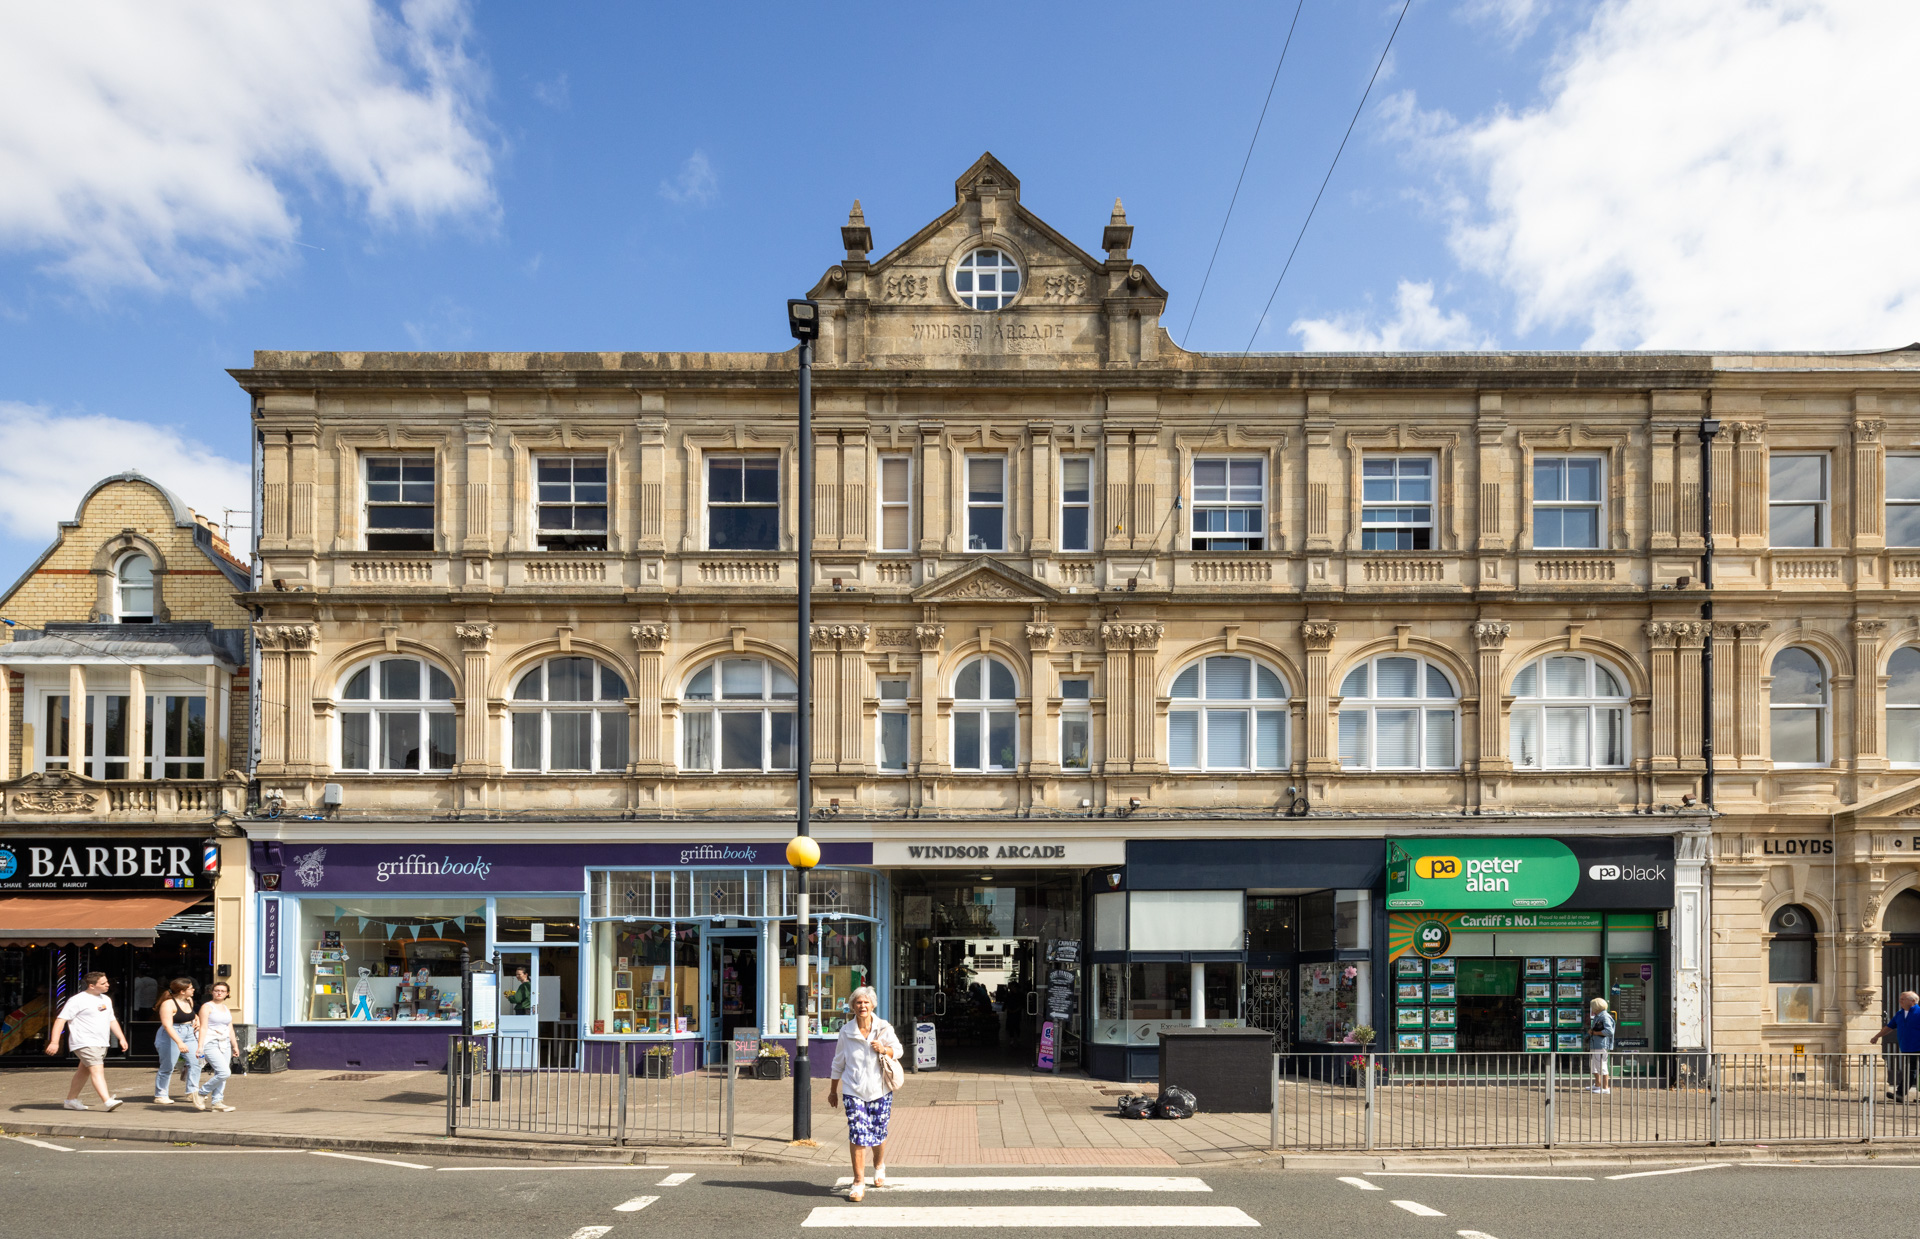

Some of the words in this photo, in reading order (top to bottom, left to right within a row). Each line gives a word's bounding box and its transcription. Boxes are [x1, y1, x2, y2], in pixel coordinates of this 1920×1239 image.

[911, 324, 983, 339] WINDSOR
[993, 324, 1064, 339] ARCADE
[908, 845, 989, 858] WINDSOR
[996, 845, 1065, 858] ARCADE
[1763, 840, 1833, 854] LLOYDS
[28, 846, 195, 877] BARBER
[1431, 859, 1456, 879] pa
[1466, 857, 1522, 878] peter
[1599, 867, 1616, 880] pa
[1622, 865, 1666, 880] black
[1466, 873, 1509, 892] alan
[1460, 915, 1512, 926] Cardiff's
[1515, 915, 1537, 926] No.1
[268, 905, 276, 969] bookshop
[1422, 928, 1442, 941] 60
[735, 1040, 757, 1053] SALE
